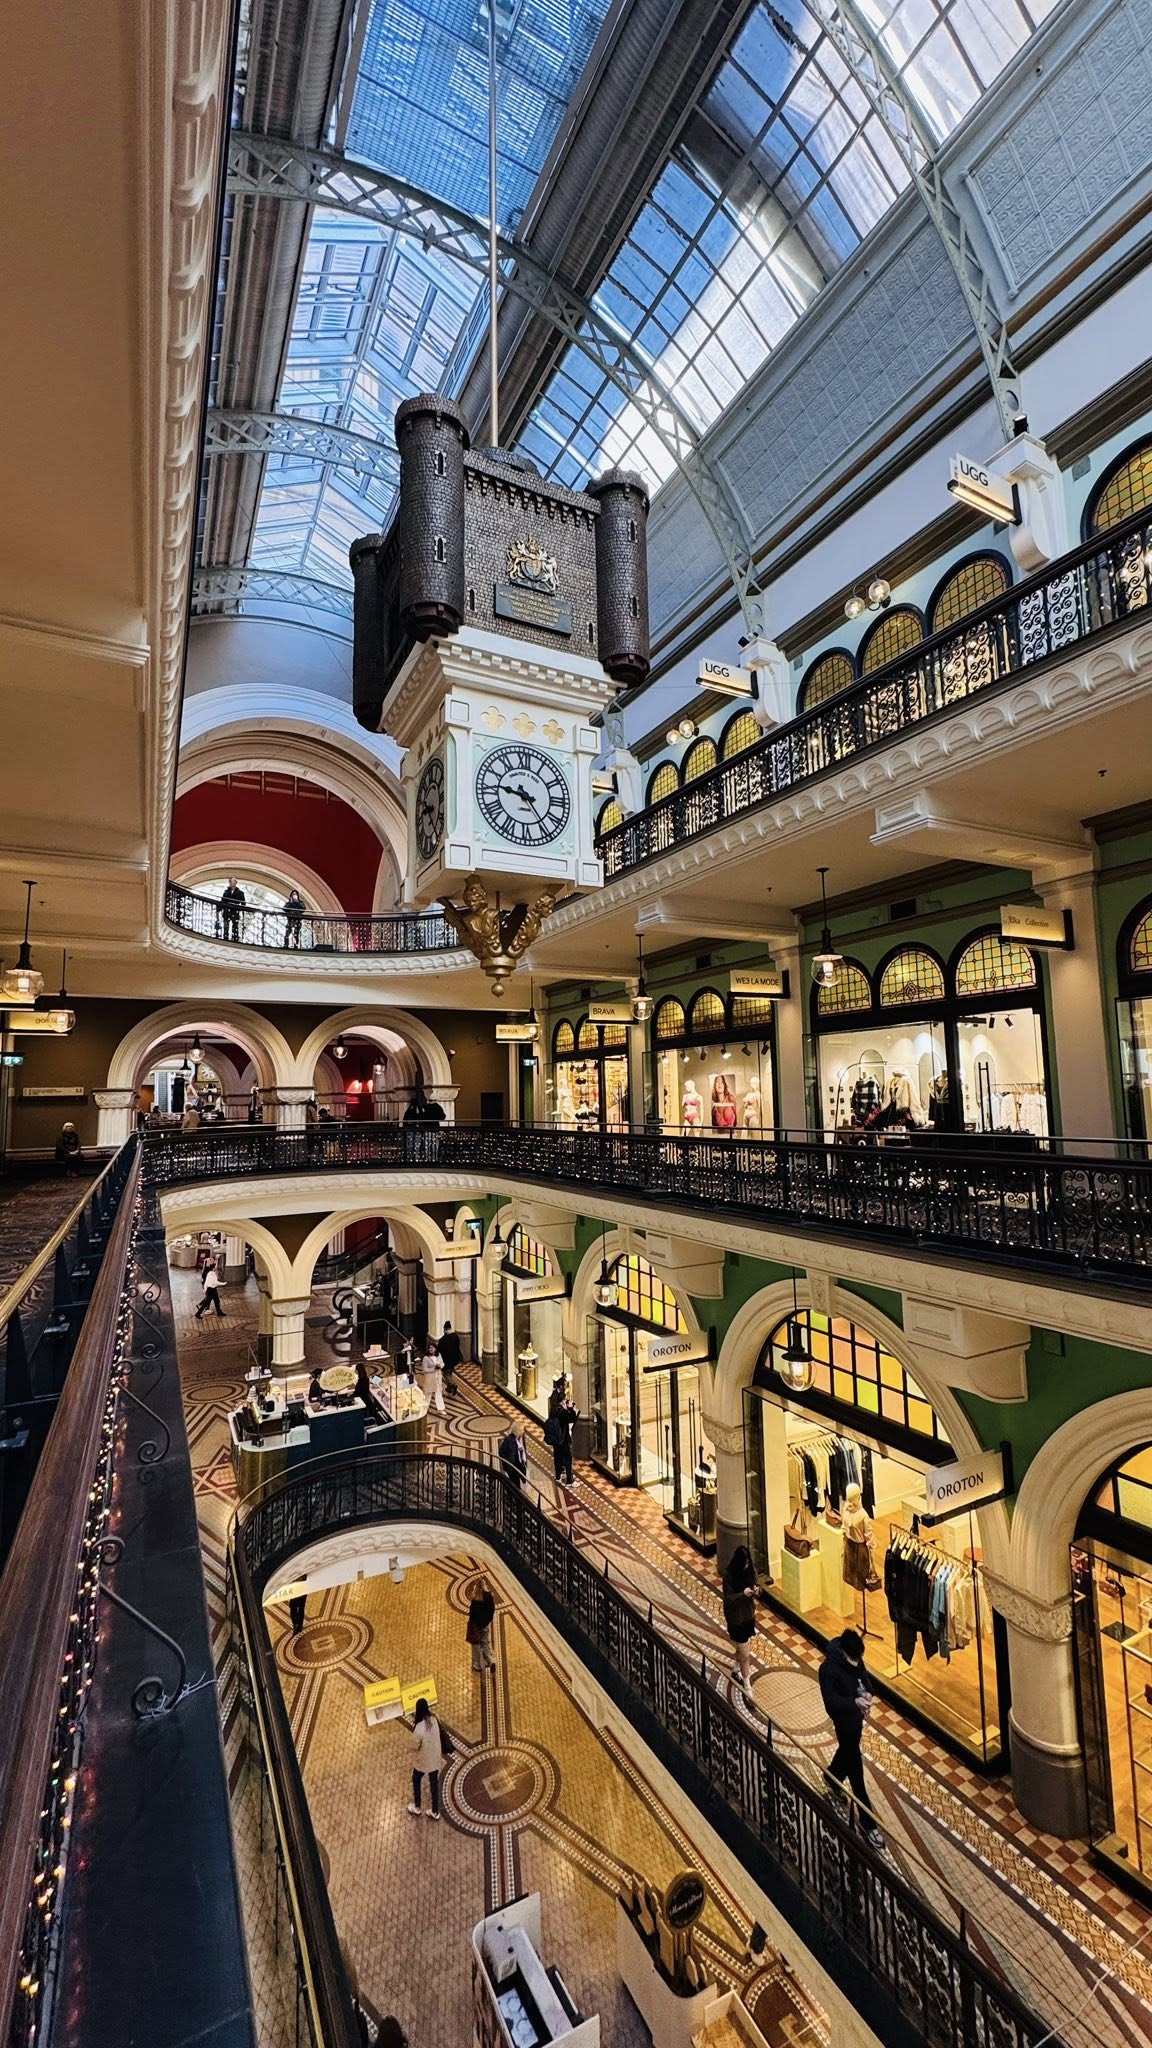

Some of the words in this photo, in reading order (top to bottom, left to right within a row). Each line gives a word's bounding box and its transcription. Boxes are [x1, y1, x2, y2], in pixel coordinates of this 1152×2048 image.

[960, 460, 989, 486] UGG
[705, 662, 730, 677] UGG
[592, 1007, 616, 1016] BRAVA
[652, 1342, 692, 1358] OROTON
[937, 1471, 984, 1500] OROTON
[371, 1687, 395, 1698] CAUTION
[408, 1688, 431, 1701] CAUTION
